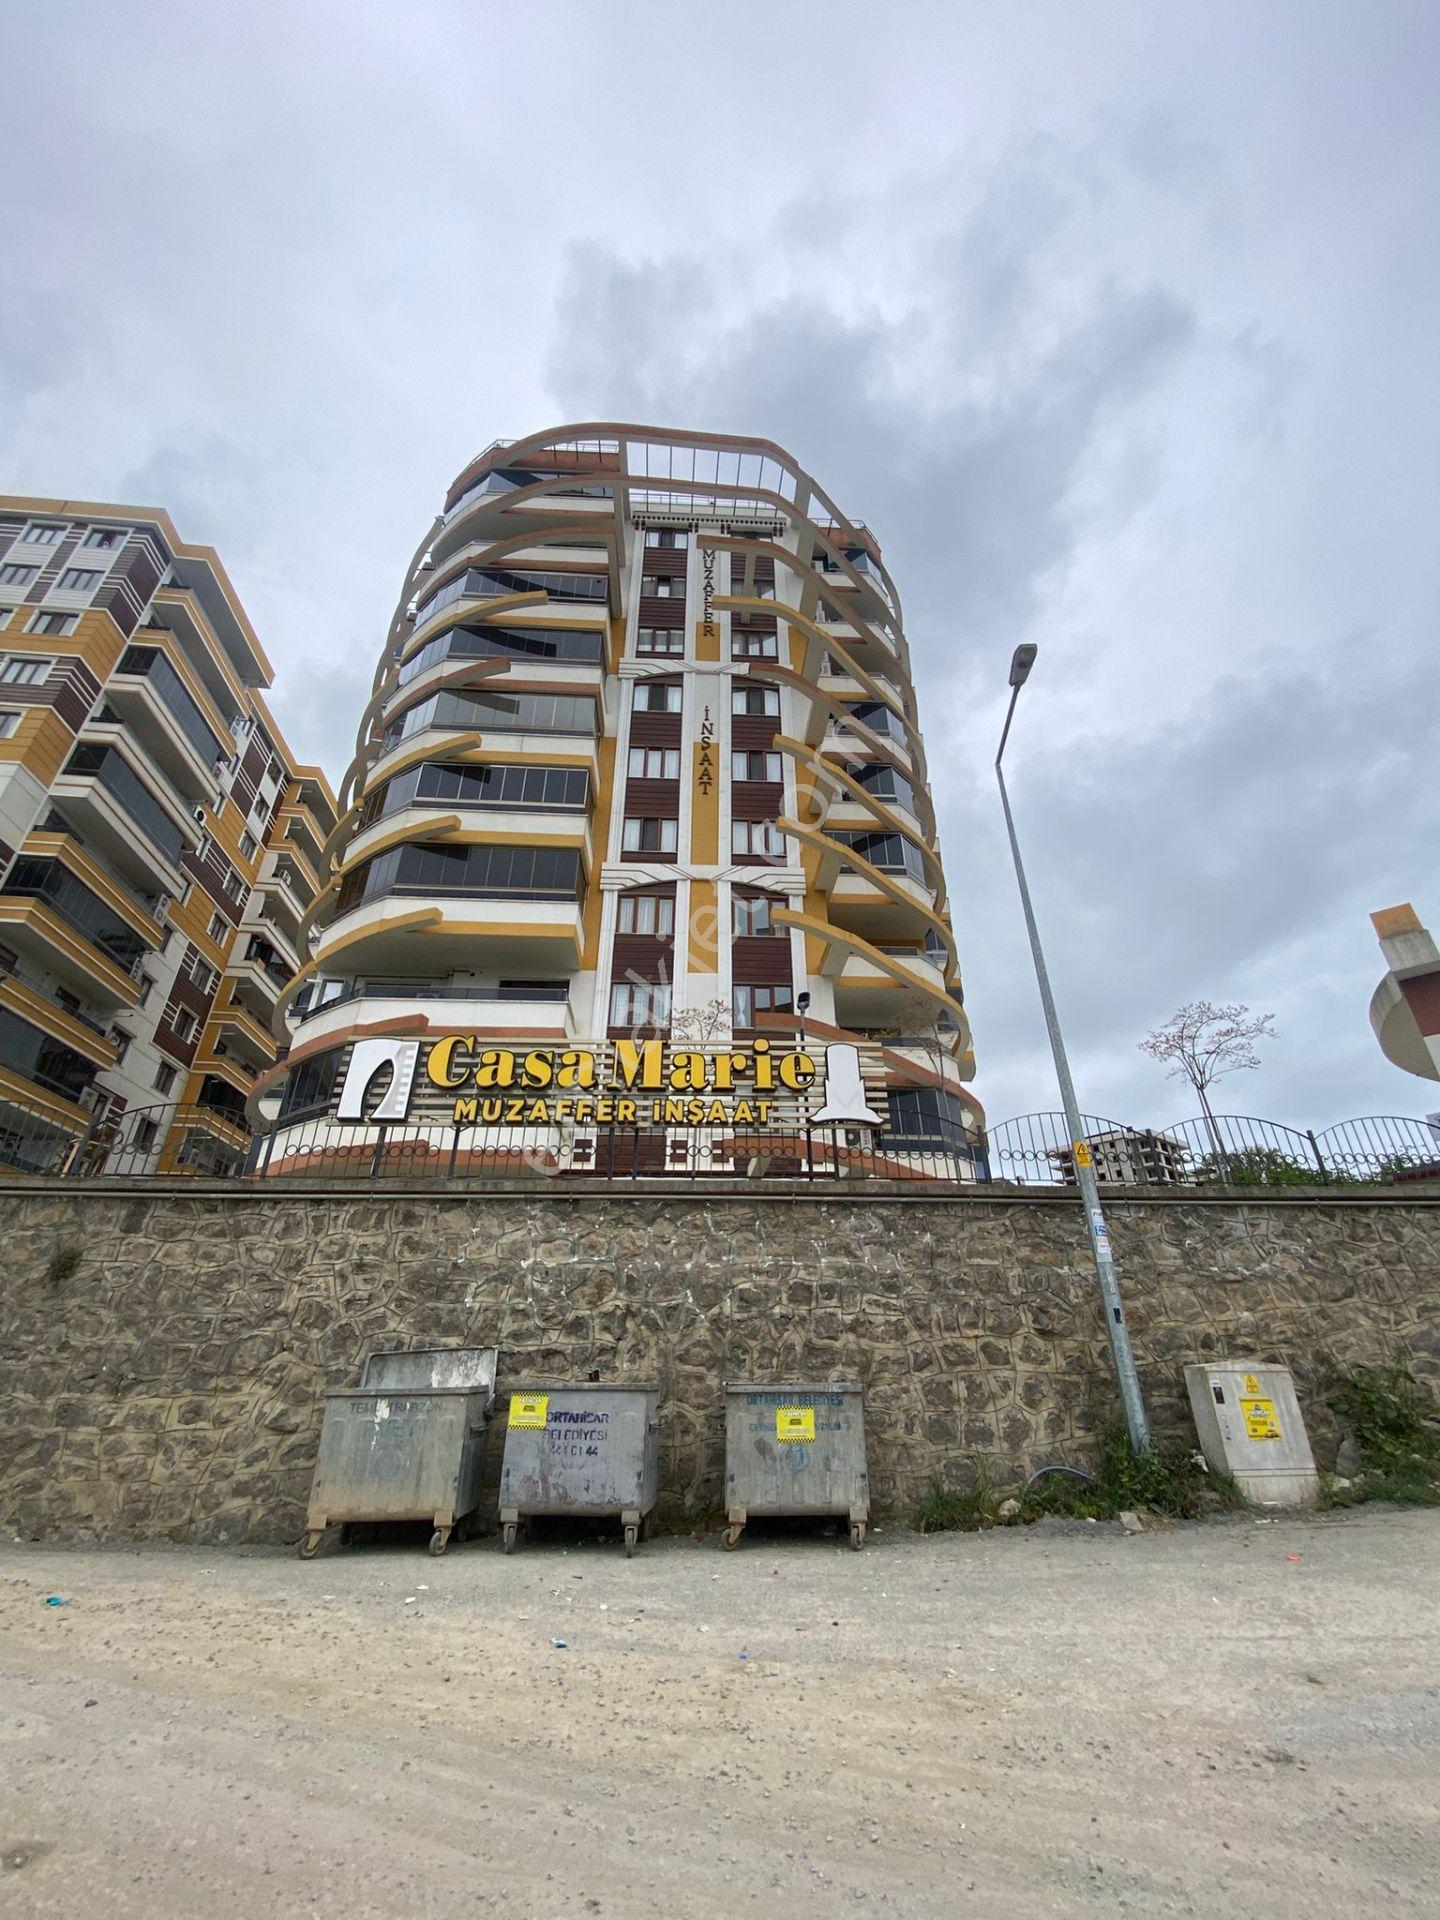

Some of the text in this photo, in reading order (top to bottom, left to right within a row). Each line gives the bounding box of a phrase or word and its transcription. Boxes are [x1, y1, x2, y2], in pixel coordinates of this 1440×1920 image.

[702, 549, 716, 637] MUZAFFER
[427, 1034, 816, 1092] Casa Marie
[453, 1098, 773, 1126] MUZAFFER İNŞAAT
[546, 1411, 609, 1423] ORTAHİSAR
